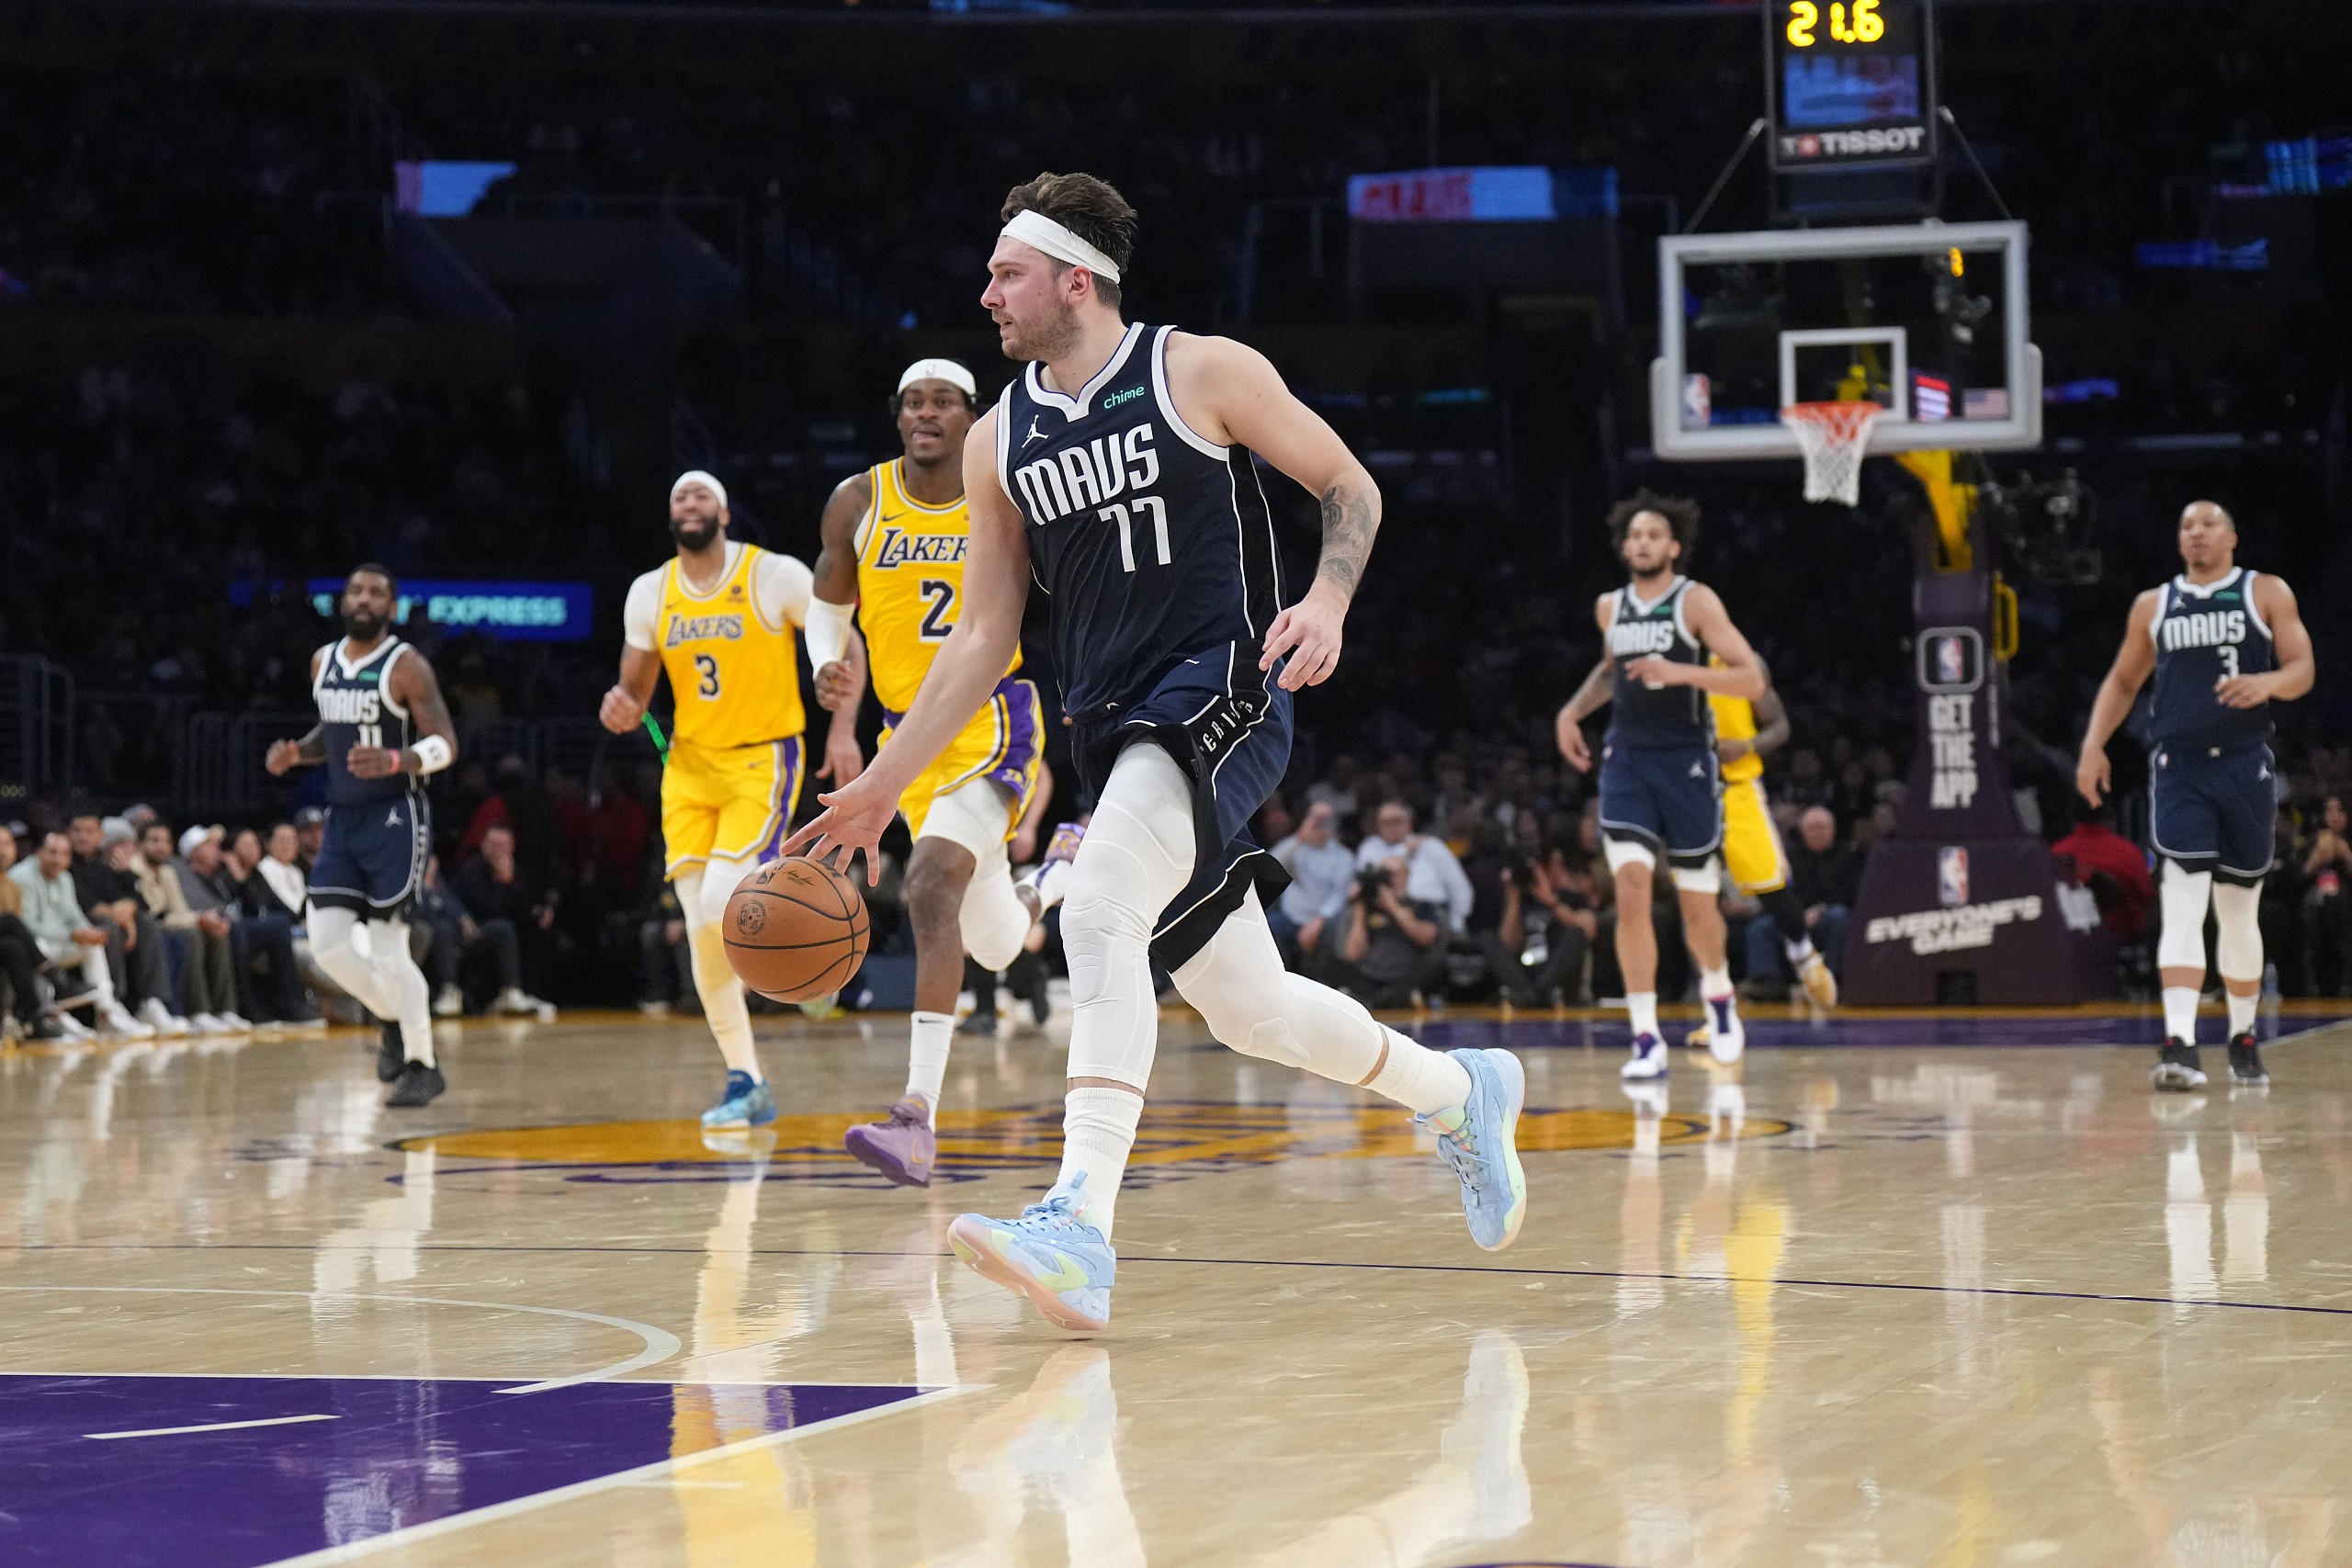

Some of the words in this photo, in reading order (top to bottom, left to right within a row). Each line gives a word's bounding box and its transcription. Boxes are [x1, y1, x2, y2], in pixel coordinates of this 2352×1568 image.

[1819, 126, 1926, 155] TISSOT
[1103, 386, 1145, 410] chime
[1015, 423, 1159, 526] MAVS
[1097, 495, 1171, 572] 77
[427, 595, 565, 626] EXPRESS
[920, 579, 956, 643] 2
[665, 613, 745, 648] LAKERS
[2163, 609, 2245, 652] MAVS
[695, 652, 721, 701] 3
[2217, 645, 2240, 683] 3
[320, 688, 381, 725] MAVS
[1928, 694, 1973, 730] GET
[1928, 732, 1976, 768] THE
[1931, 770, 1978, 808] APP
[1865, 894, 2042, 944] EVERYONE'S
[1911, 922, 1995, 956] GAME
